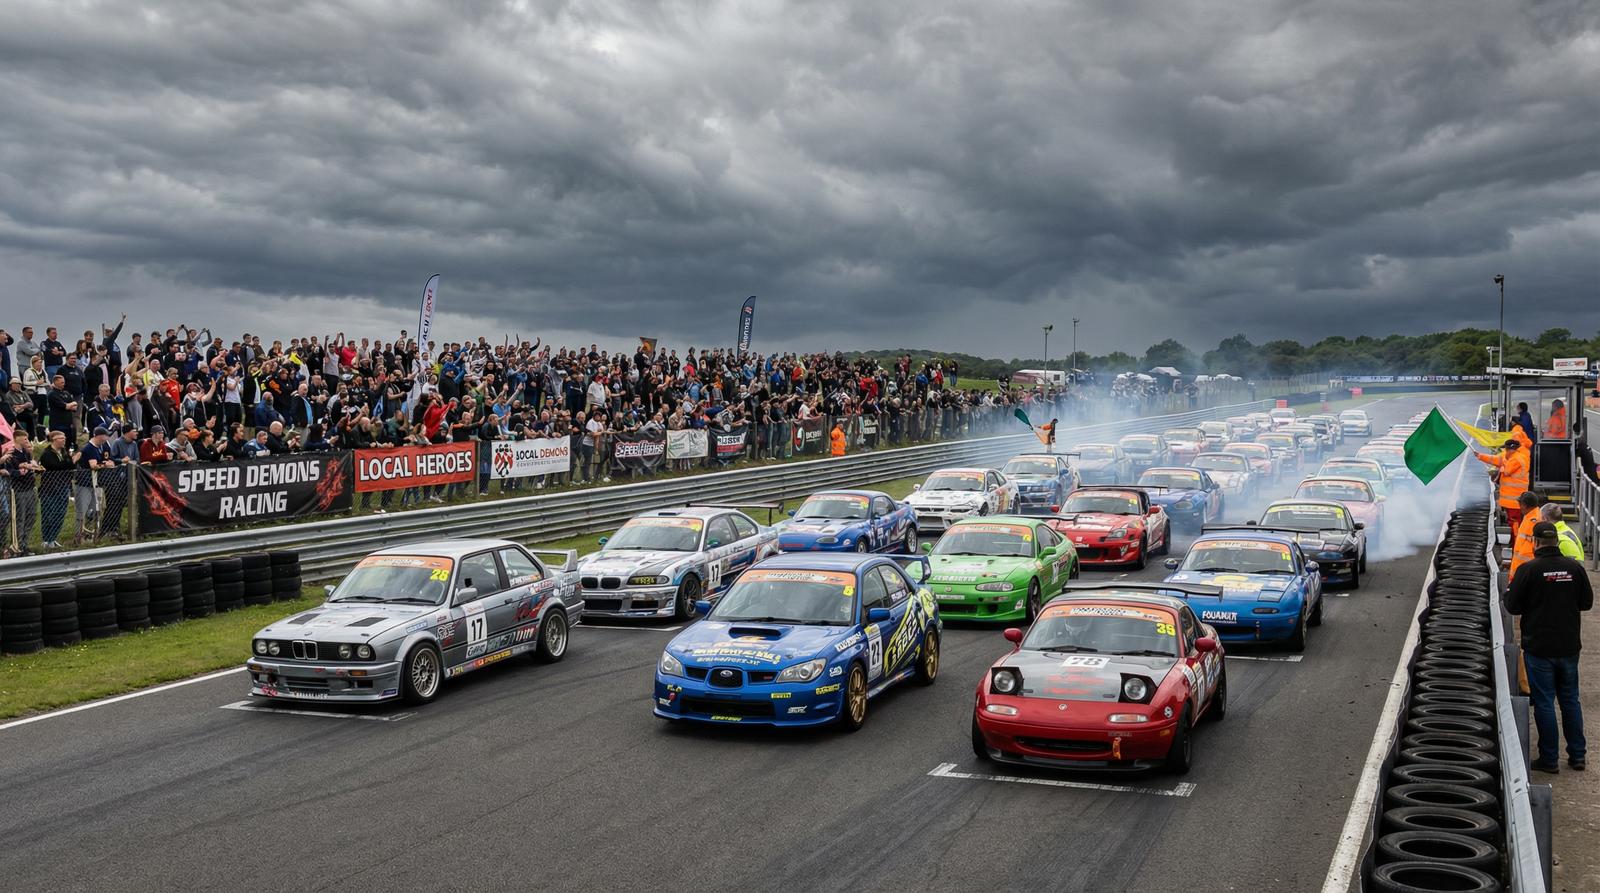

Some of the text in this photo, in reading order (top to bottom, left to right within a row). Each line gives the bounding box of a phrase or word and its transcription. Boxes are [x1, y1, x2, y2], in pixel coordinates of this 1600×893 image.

[540, 446, 569, 459] DEMONS
[178, 459, 320, 493] SPEED DEMONS
[359, 450, 473, 482] LOCAL HEROES
[219, 490, 288, 520] RACING
[430, 568, 449, 581] 28
[471, 618, 483, 641] 17
